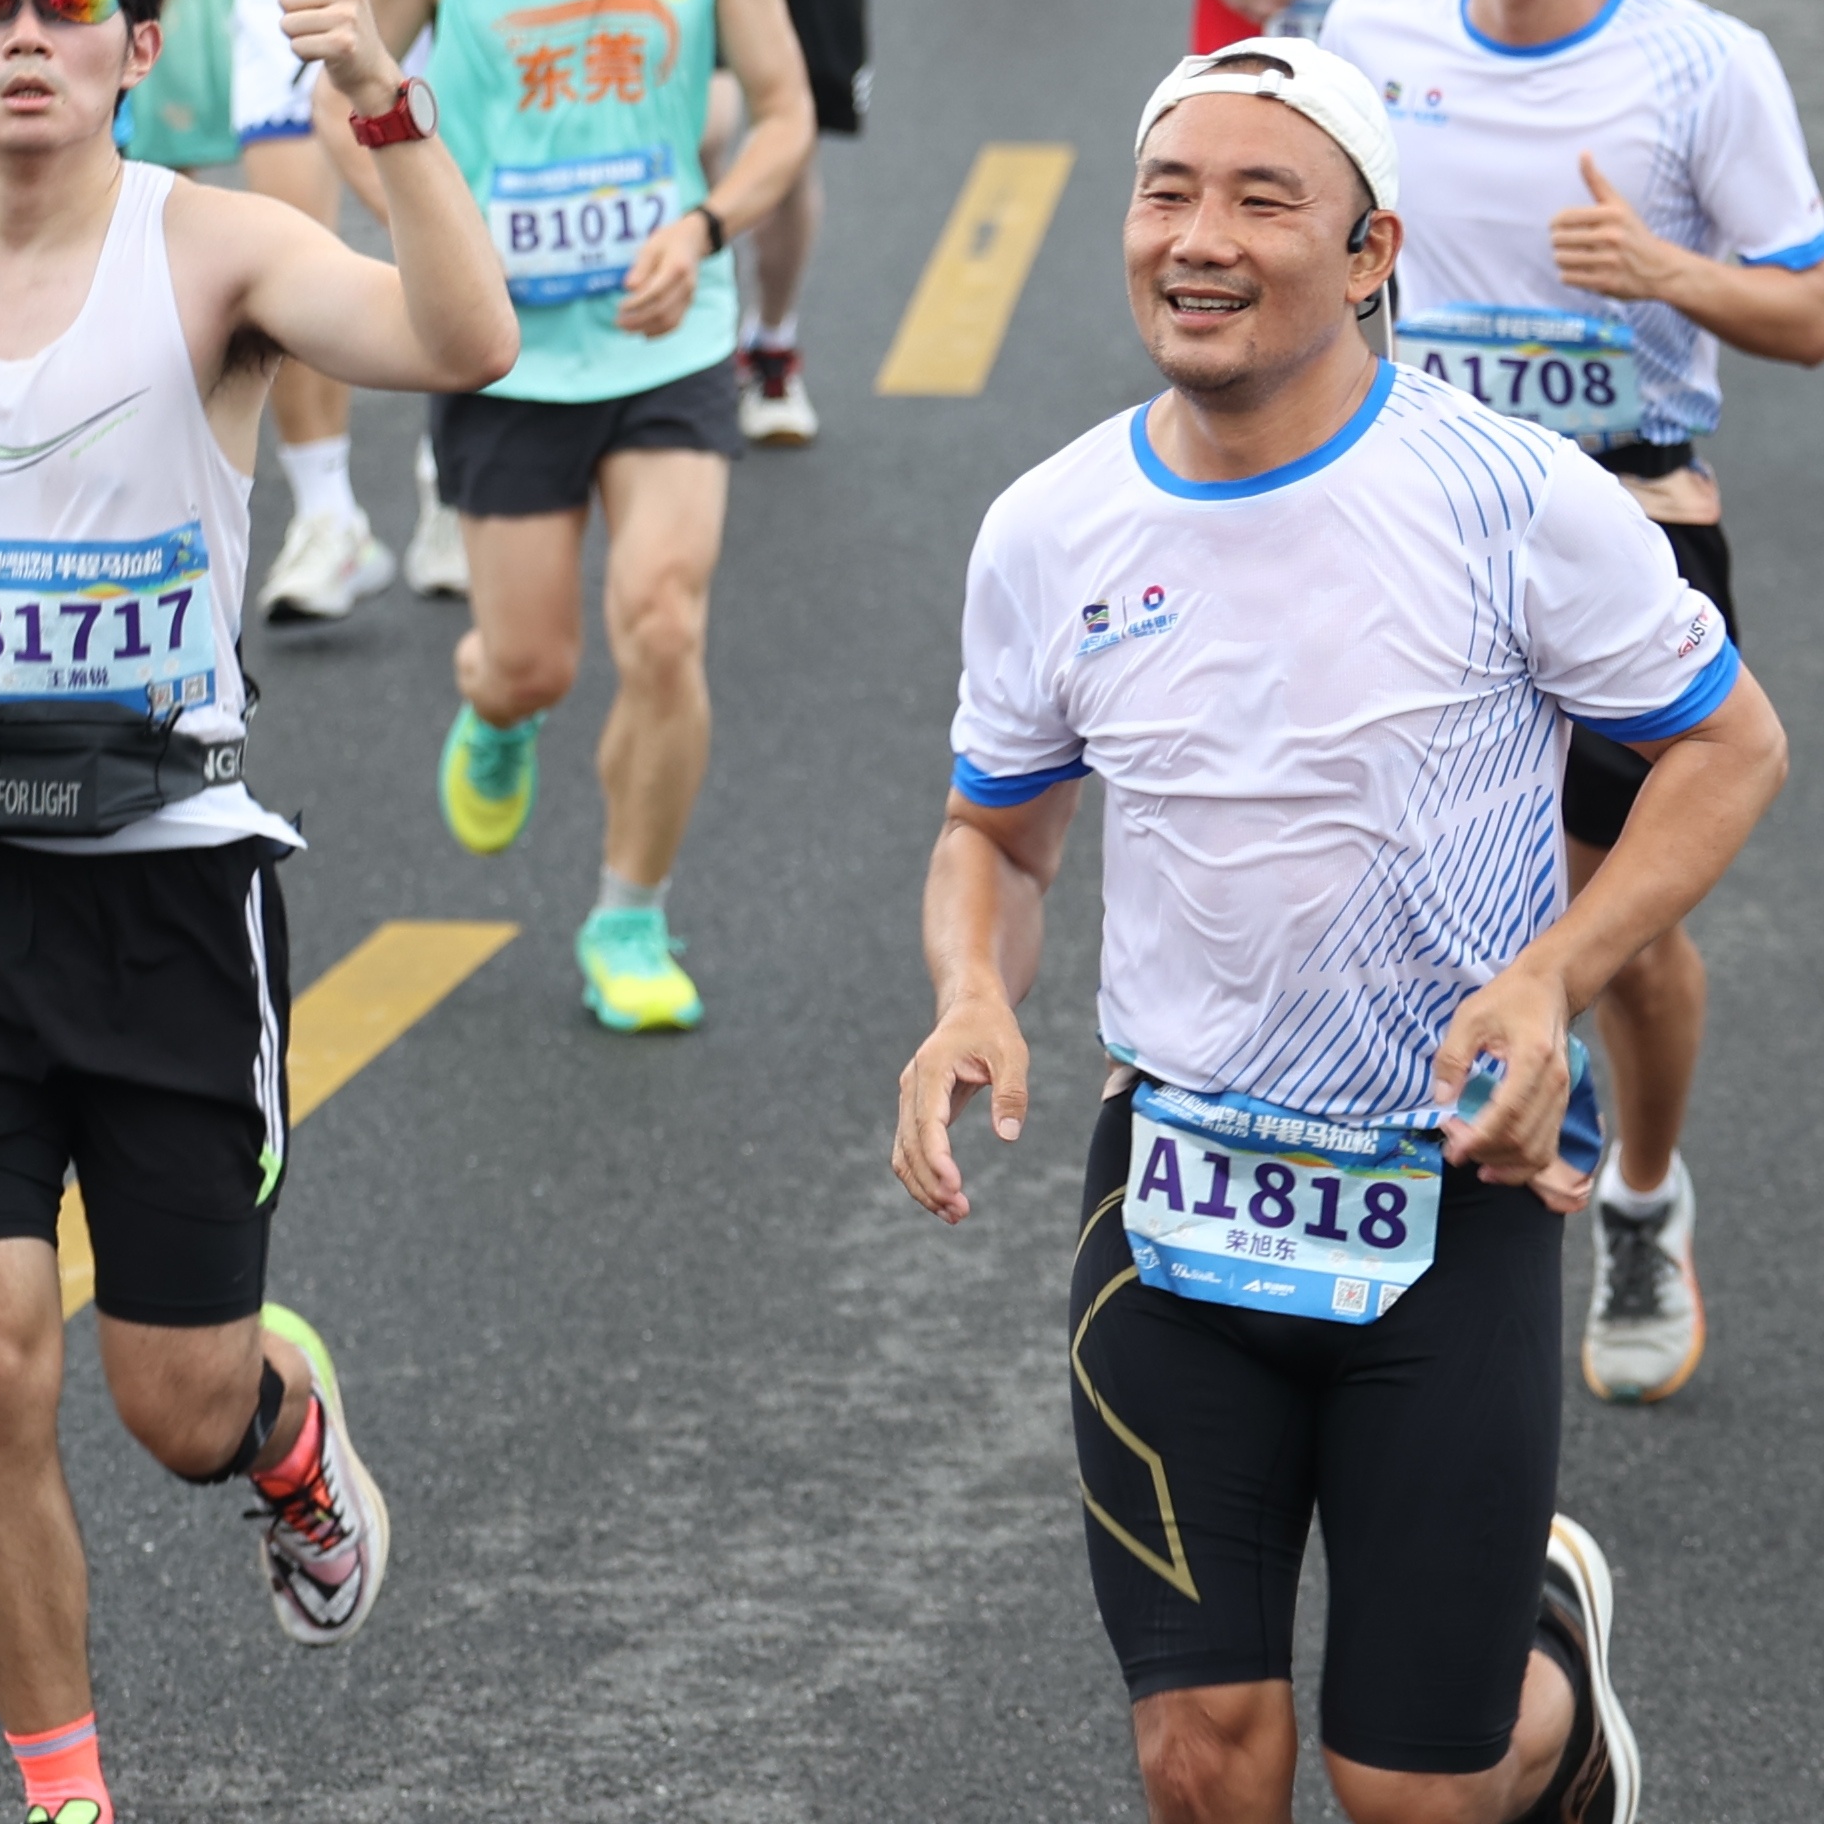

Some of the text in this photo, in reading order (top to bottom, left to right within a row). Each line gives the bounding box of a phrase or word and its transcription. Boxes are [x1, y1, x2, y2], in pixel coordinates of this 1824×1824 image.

[515, 31, 646, 113] 东莞
[1423, 351, 1616, 406] A1708
[31, 781, 81, 817] LIGHT
[1253, 1114, 1380, 1155] 半程马拉松
[1136, 1135, 1408, 1250] A1818
[1225, 1228, 1298, 1261] 荣旭东
